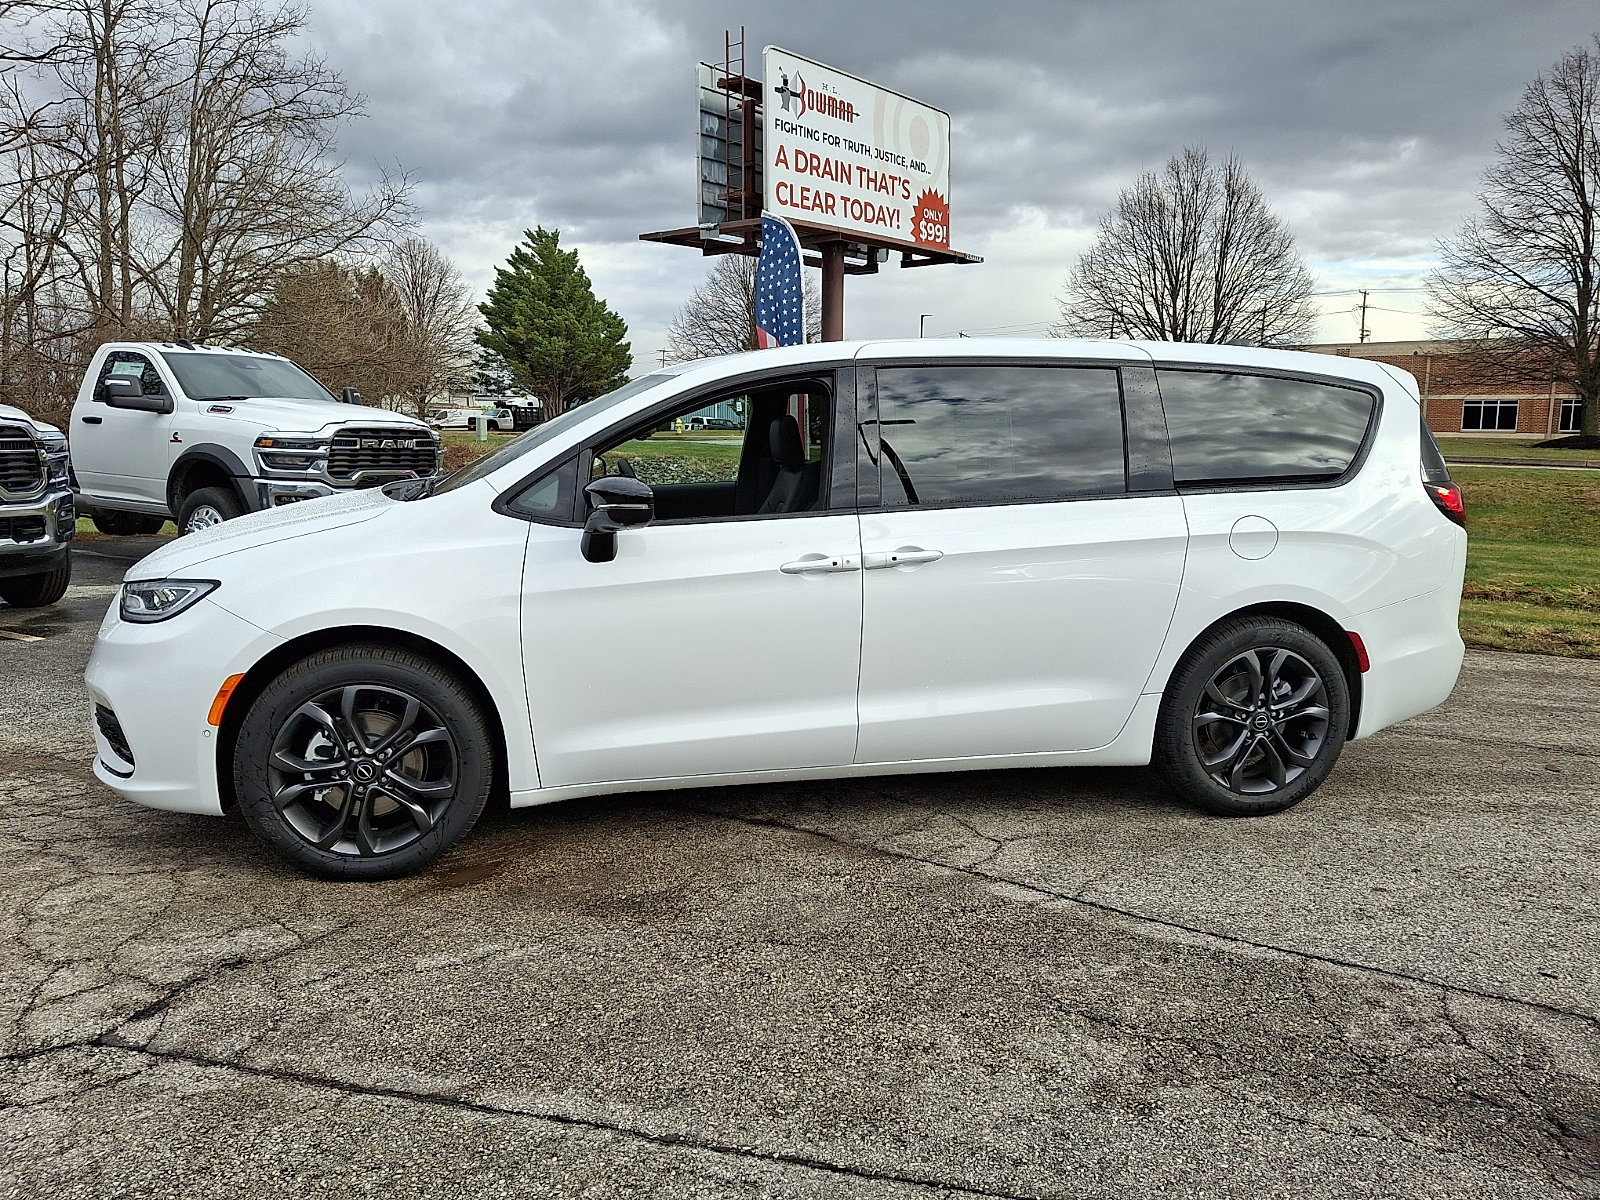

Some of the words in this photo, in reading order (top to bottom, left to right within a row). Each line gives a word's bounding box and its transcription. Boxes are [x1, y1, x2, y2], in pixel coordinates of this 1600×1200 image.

[796, 71, 854, 123] BOWMAN
[821, 82, 841, 96] H.L.
[774, 117, 820, 142] FIGHTING
[822, 132, 841, 149] FOR
[842, 138, 873, 160] TRUTH,
[874, 147, 909, 170] JUSTICE,
[910, 159, 932, 175] AND...
[774, 144, 790, 171] A
[794, 148, 852, 186] DRAIN
[856, 165, 911, 200] THAT'S
[775, 181, 837, 217] CLEAR
[840, 195, 901, 230] TODAY!
[923, 207, 943, 222] ONLY
[919, 218, 947, 244] $99!
[361, 438, 414, 449] RAM
